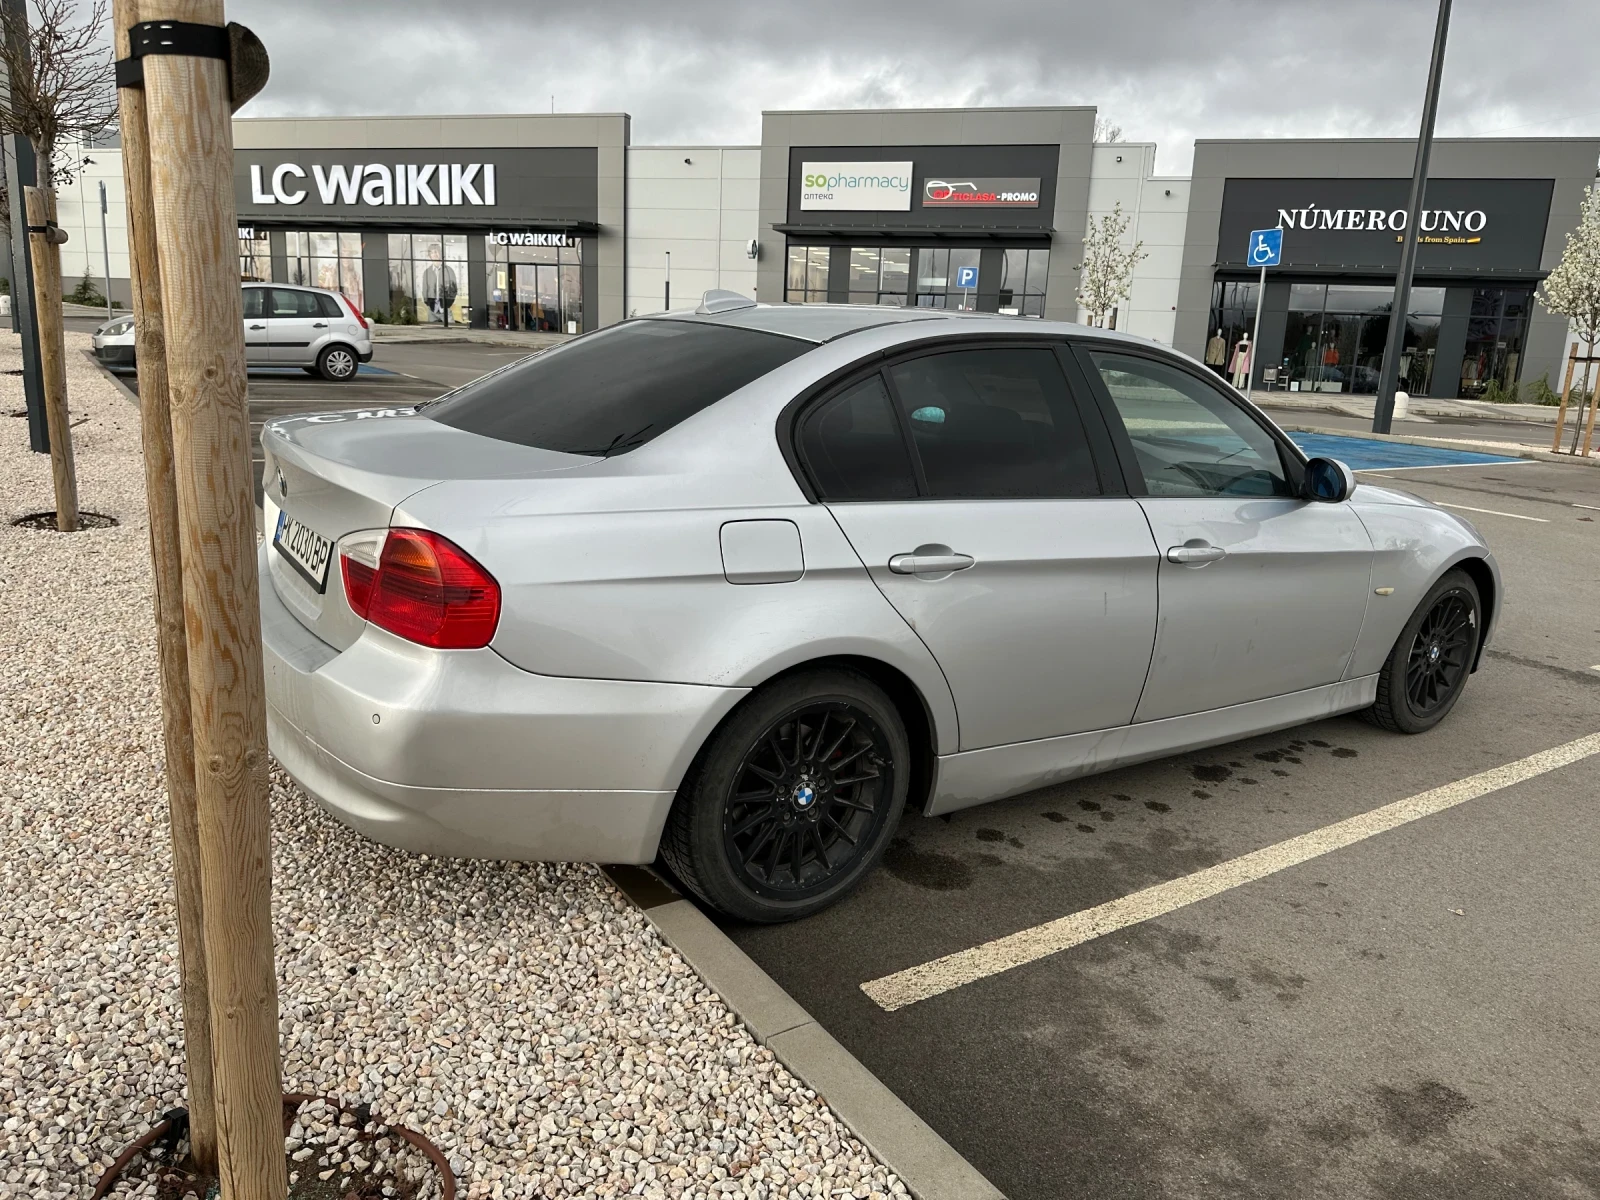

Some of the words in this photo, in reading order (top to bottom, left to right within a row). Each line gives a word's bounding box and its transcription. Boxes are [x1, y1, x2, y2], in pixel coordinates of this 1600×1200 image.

[250, 163, 307, 205] LC
[805, 173, 909, 192] sopharmacy
[1276, 203, 1407, 231] NÚMERO
[1420, 211, 1487, 231] UNO
[489, 232, 508, 245] LC
[1443, 236, 1466, 245] Spain
[961, 269, 973, 285] P
[291, 522, 315, 564] 2030
[311, 536, 328, 574] BP
